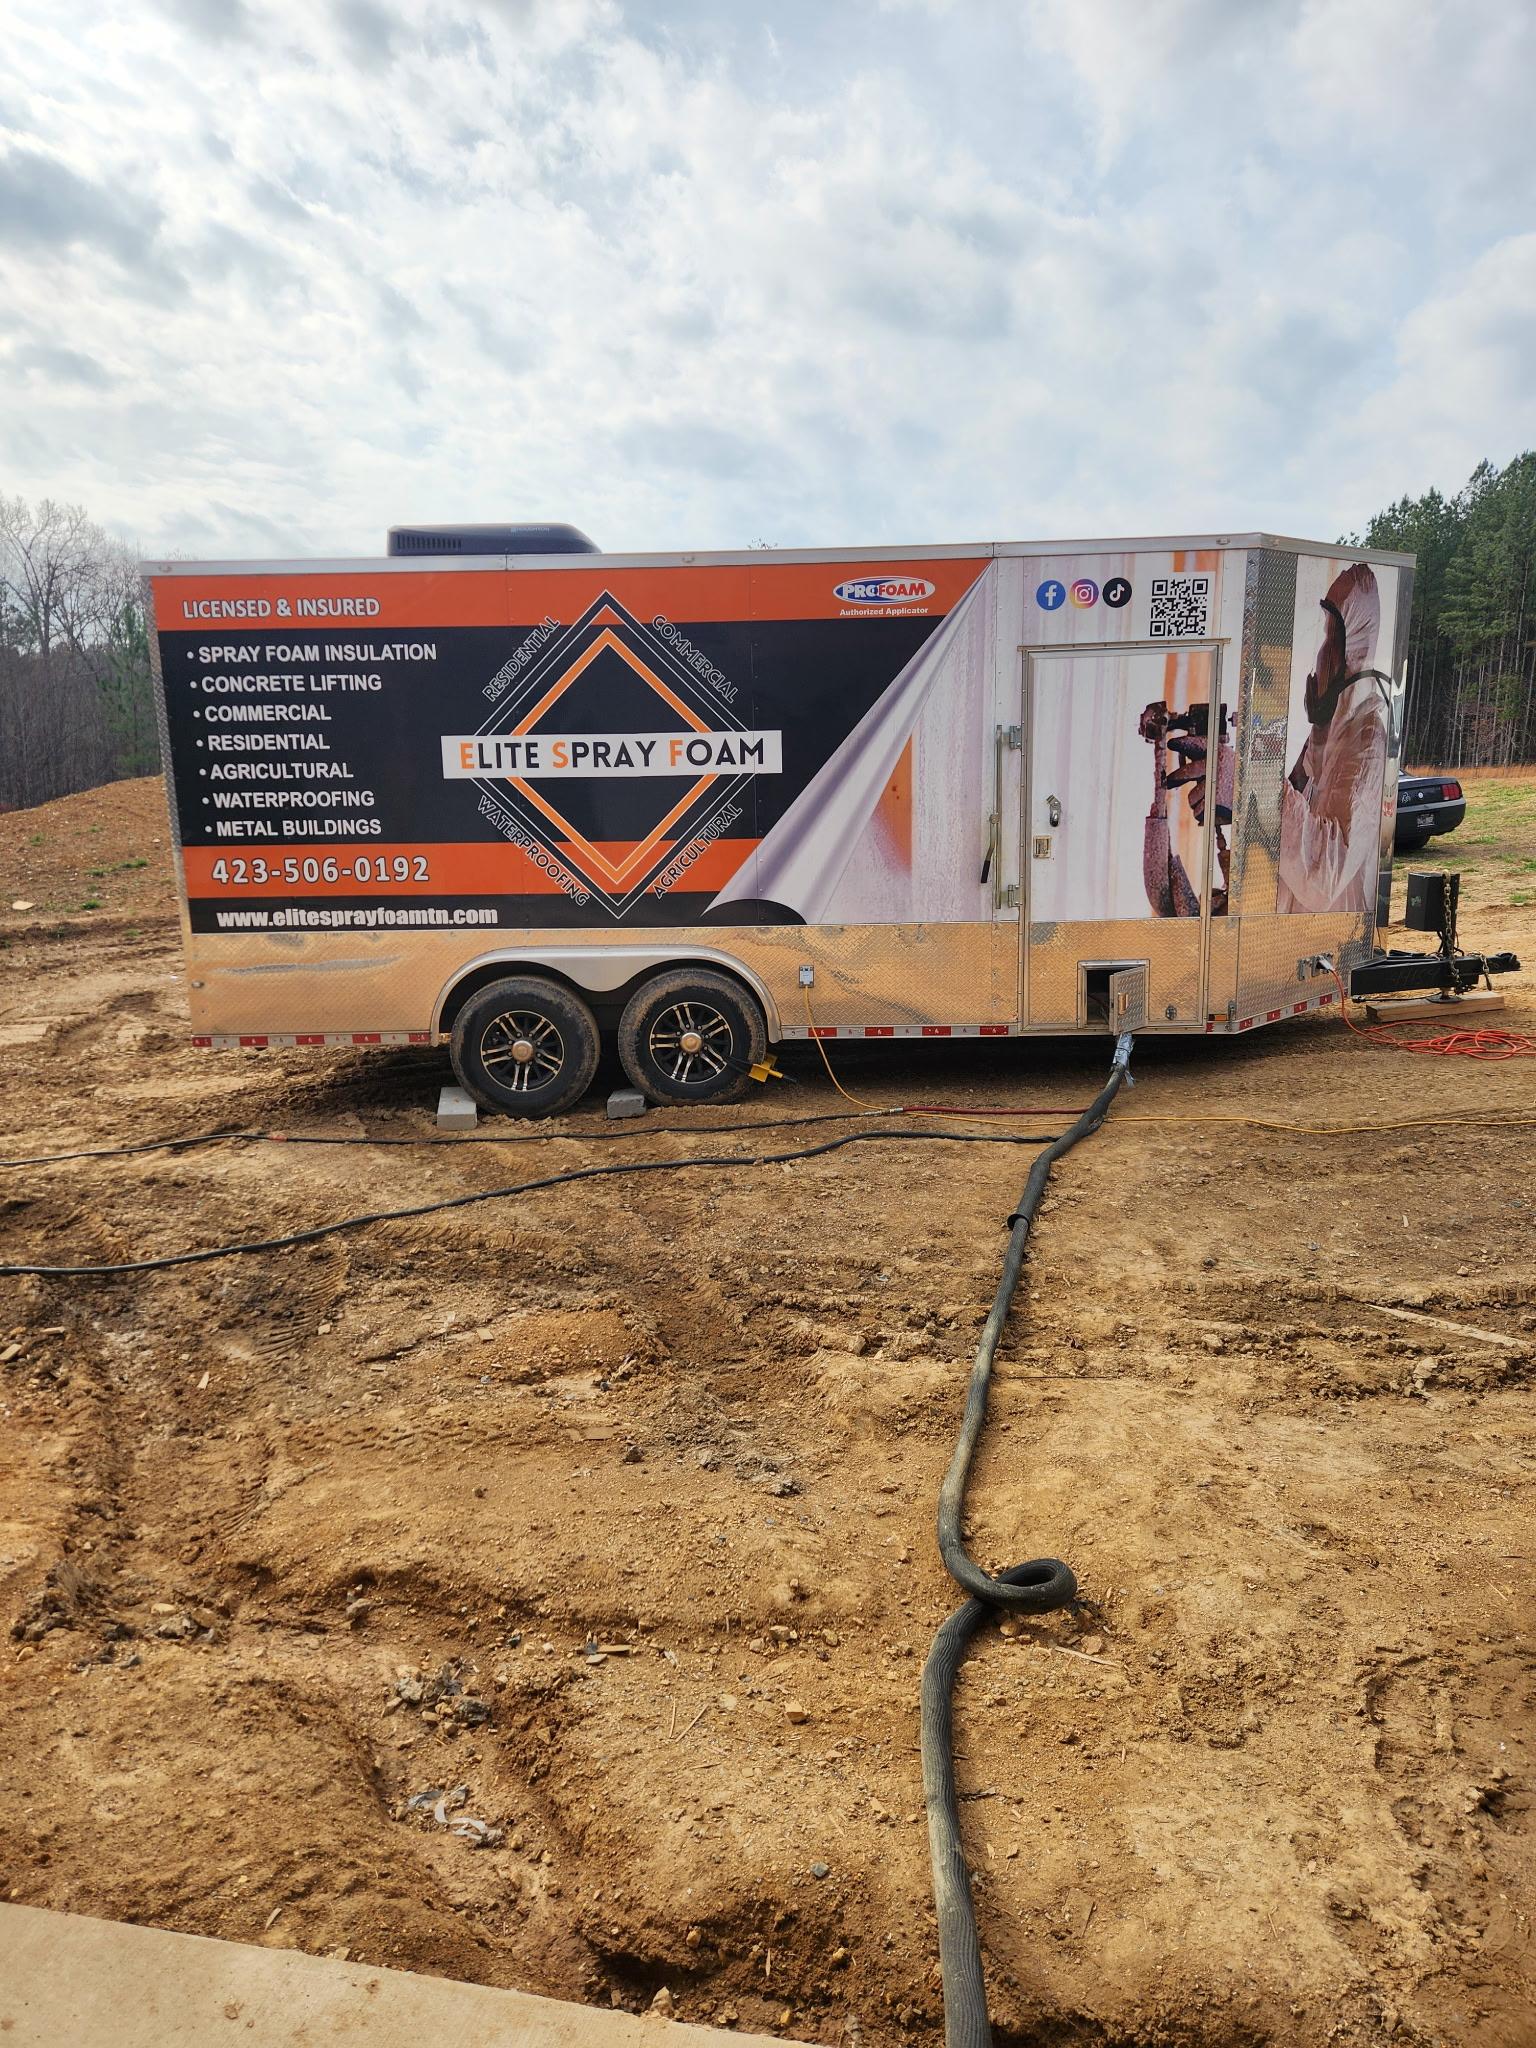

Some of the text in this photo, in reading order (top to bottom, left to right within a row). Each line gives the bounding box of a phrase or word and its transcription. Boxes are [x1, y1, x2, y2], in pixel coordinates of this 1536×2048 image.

[842, 583, 926, 598] PROFOAM
[183, 597, 380, 618] LICENSED & INSURED
[840, 607, 928, 616] Authorized Applicator
[199, 643, 437, 663] SPRAY FOAM INSULATION
[482, 615, 560, 702] RESIDENTIAL
[652, 614, 739, 703] COMMERCIAL
[202, 674, 382, 692] CONCRETE LIFTING
[205, 705, 331, 721] COMMERCIAL
[208, 734, 330, 751] RESIDENTIAL
[459, 738, 765, 769] ELITE SPRAY FOAM
[210, 763, 354, 780] AGRICULTURAL
[213, 791, 375, 808] WATERPROOFING
[216, 819, 382, 837] METAL BUILDINGS
[477, 795, 590, 906] WATERPROOFING
[653, 803, 743, 899] AGRICULTURAL
[211, 856, 430, 884] 423-506-0192
[216, 907, 499, 927] www.elitesprayfoamtn.com
